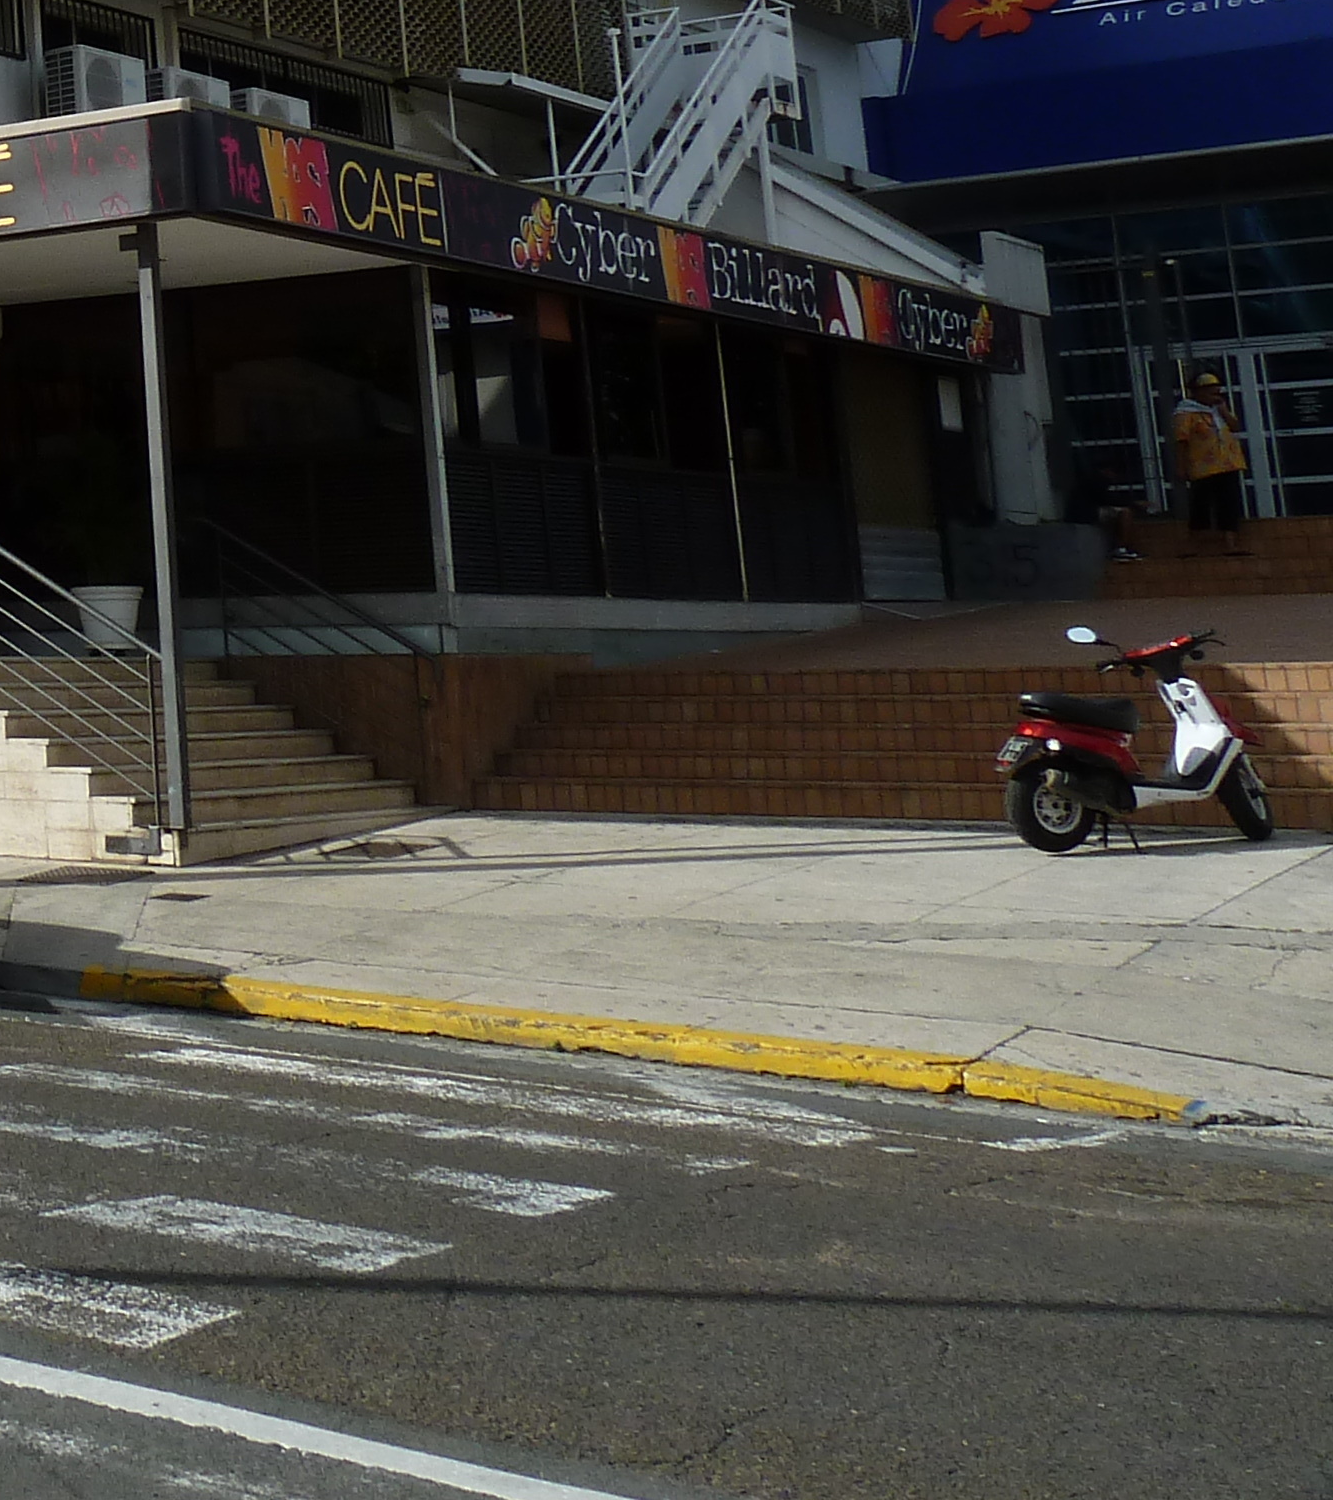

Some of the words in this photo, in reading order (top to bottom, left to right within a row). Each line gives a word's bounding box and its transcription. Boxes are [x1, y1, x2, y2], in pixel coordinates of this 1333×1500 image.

[1099, 8, 1147, 26] Air
[219, 126, 263, 204] The
[339, 160, 442, 247] CAFÉ
[552, 202, 656, 283] Cyber
[708, 241, 821, 326] Billard
[897, 288, 967, 351] Cyber
